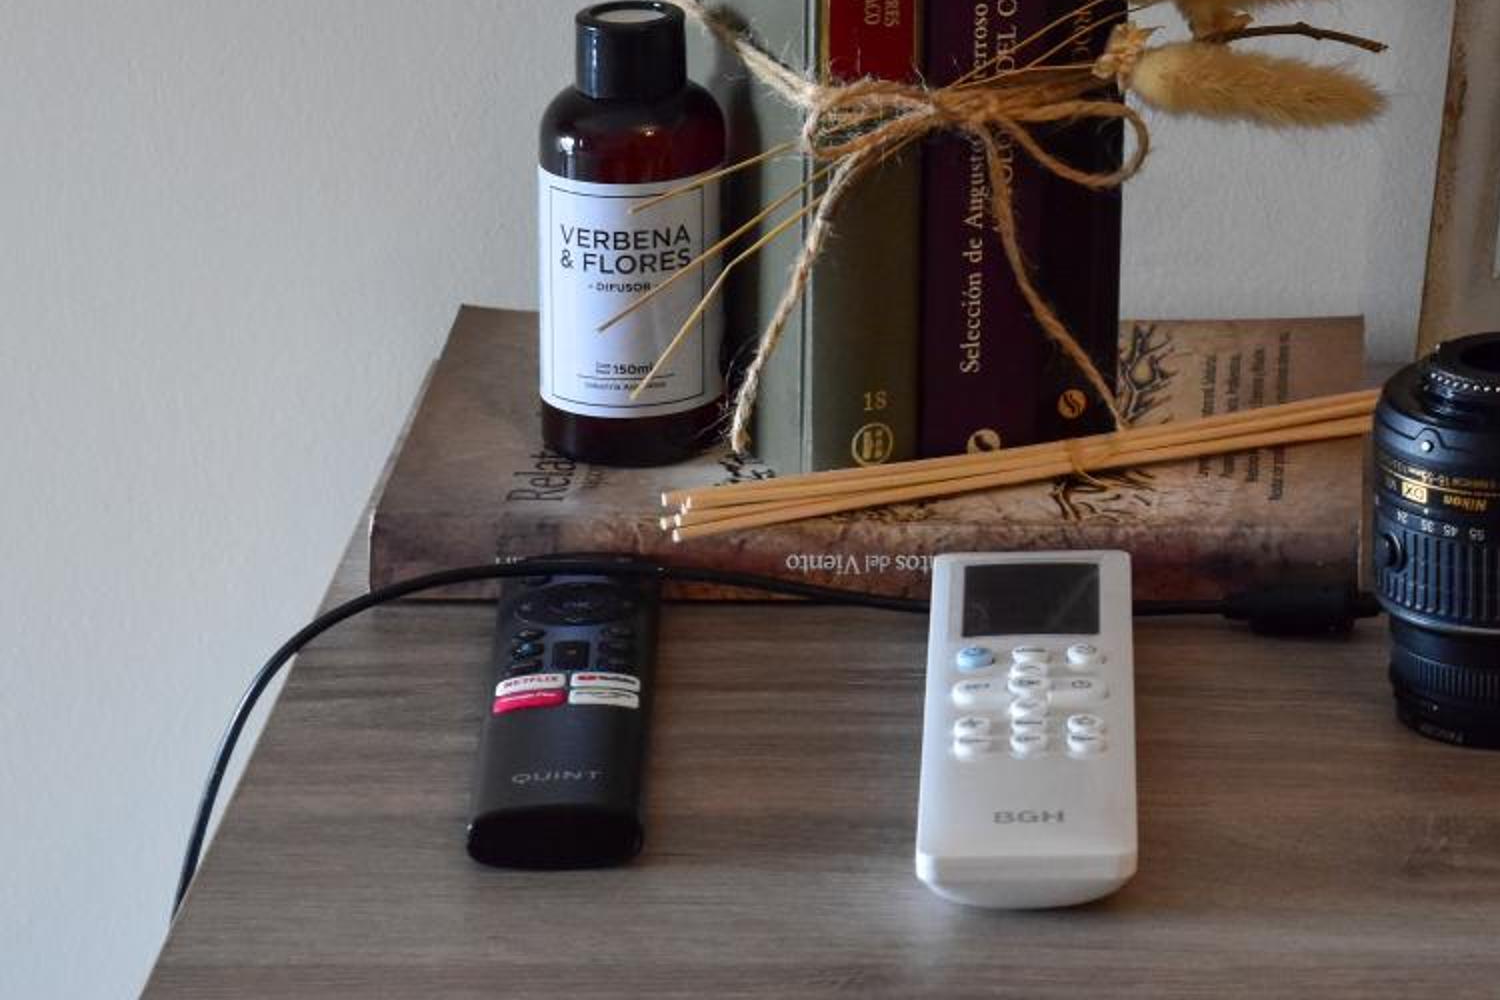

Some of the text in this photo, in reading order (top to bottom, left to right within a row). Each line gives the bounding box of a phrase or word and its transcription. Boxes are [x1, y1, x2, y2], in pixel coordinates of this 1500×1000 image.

[559, 224, 691, 252] VERBENA
[962, 237, 984, 263] de
[560, 248, 692, 275] & FLORES
[595, 281, 652, 294] DIFUSOR
[959, 271, 984, 374] Selección
[612, 360, 654, 377] 150ml
[785, 552, 861, 575] Viento
[864, 554, 891, 573] del
[511, 769, 602, 785] QUINT
[993, 810, 1066, 825] BGH
